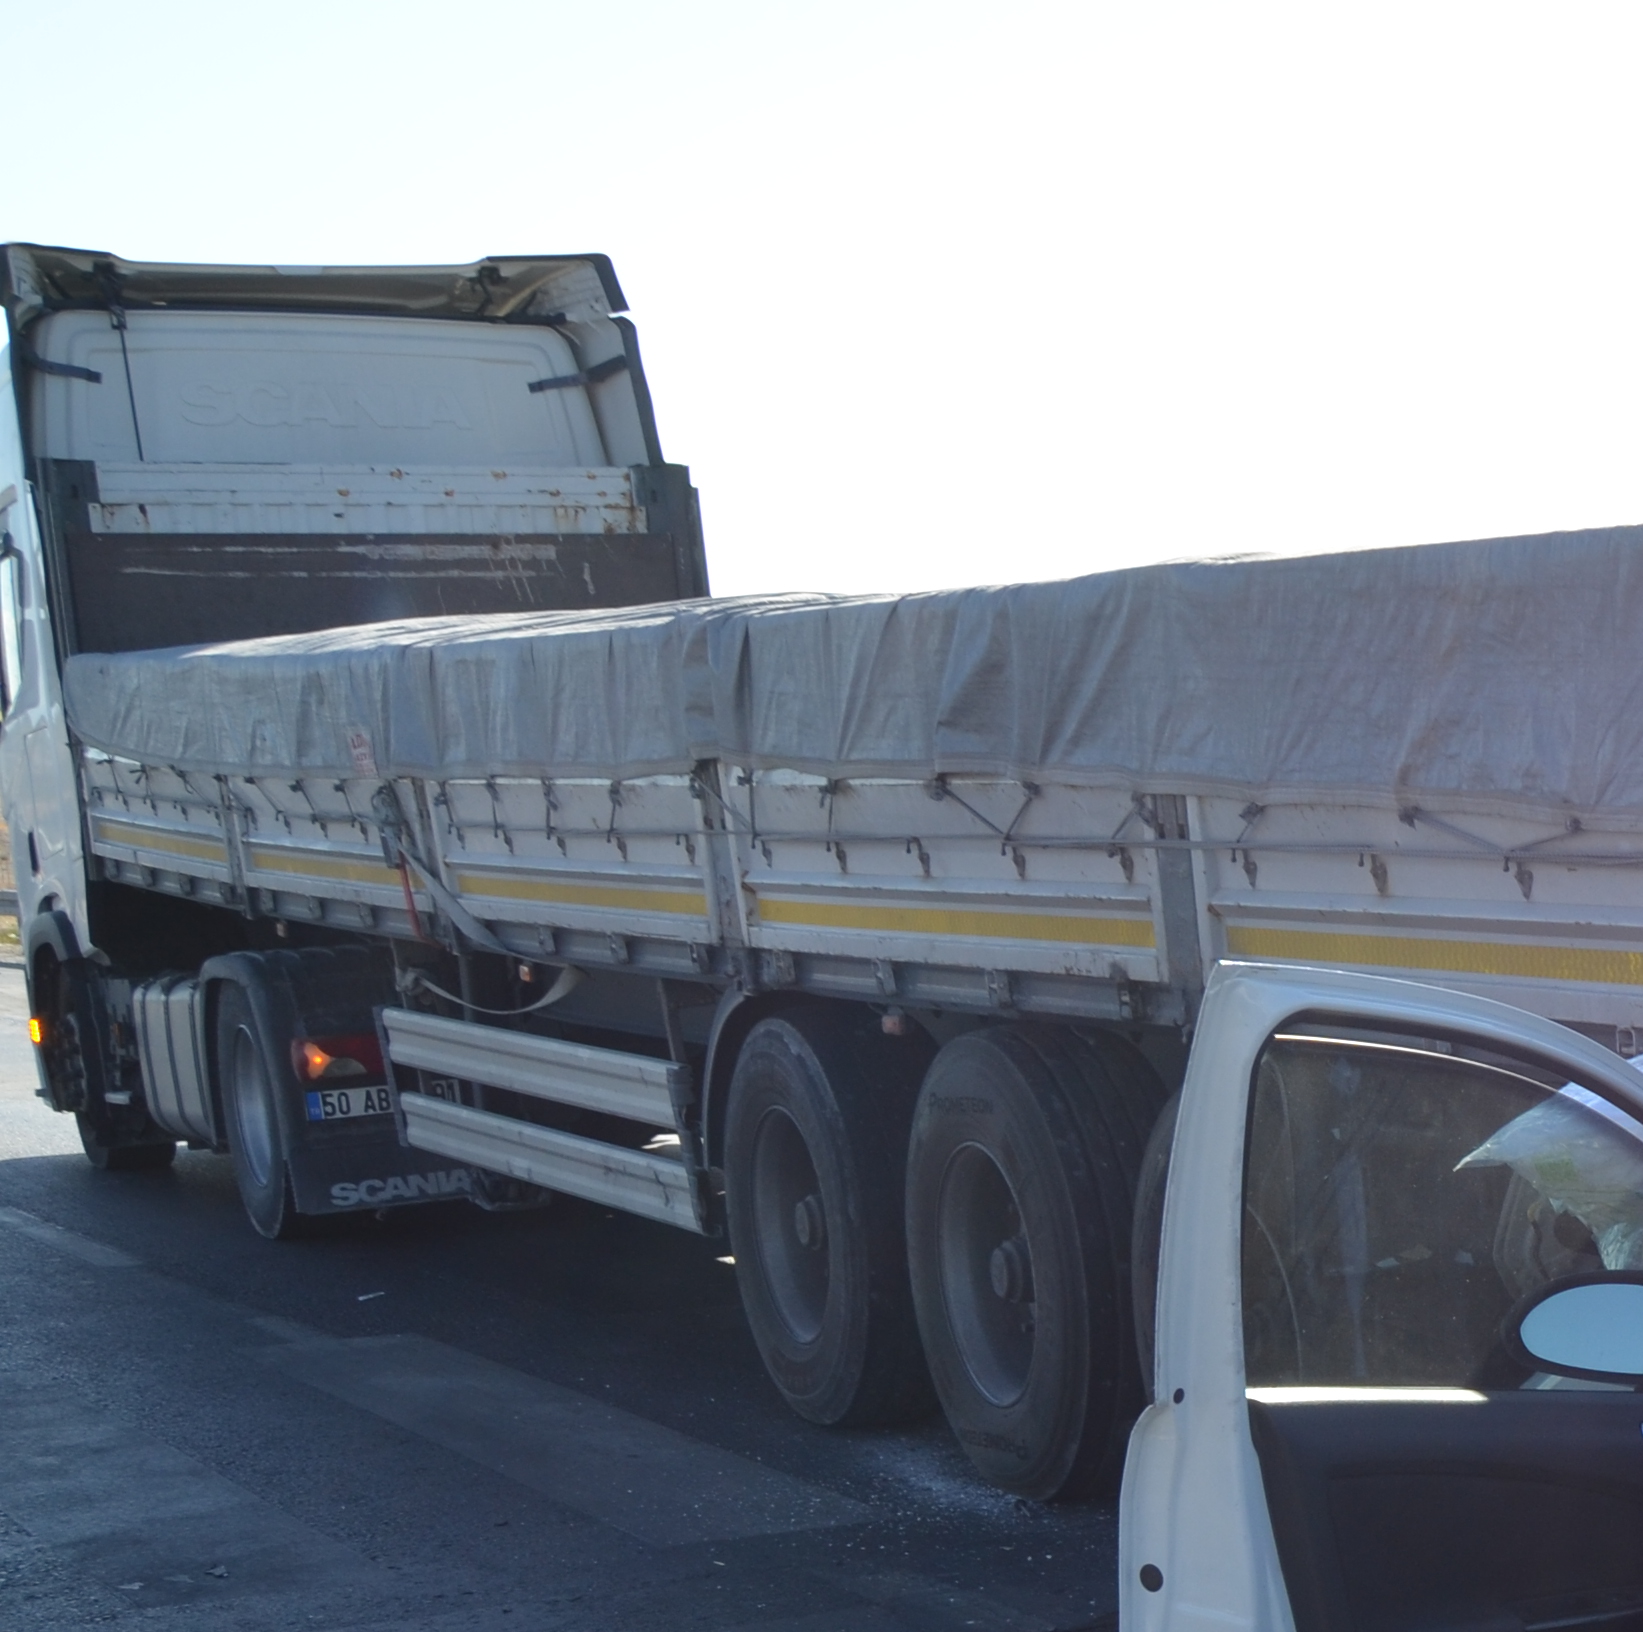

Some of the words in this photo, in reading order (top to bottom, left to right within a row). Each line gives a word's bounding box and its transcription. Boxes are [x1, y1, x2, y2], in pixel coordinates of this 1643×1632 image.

[178, 379, 474, 431] SCANIA
[321, 1091, 350, 1117] 50
[363, 1088, 392, 1113] AB
[330, 1168, 472, 1207] SCANIA
